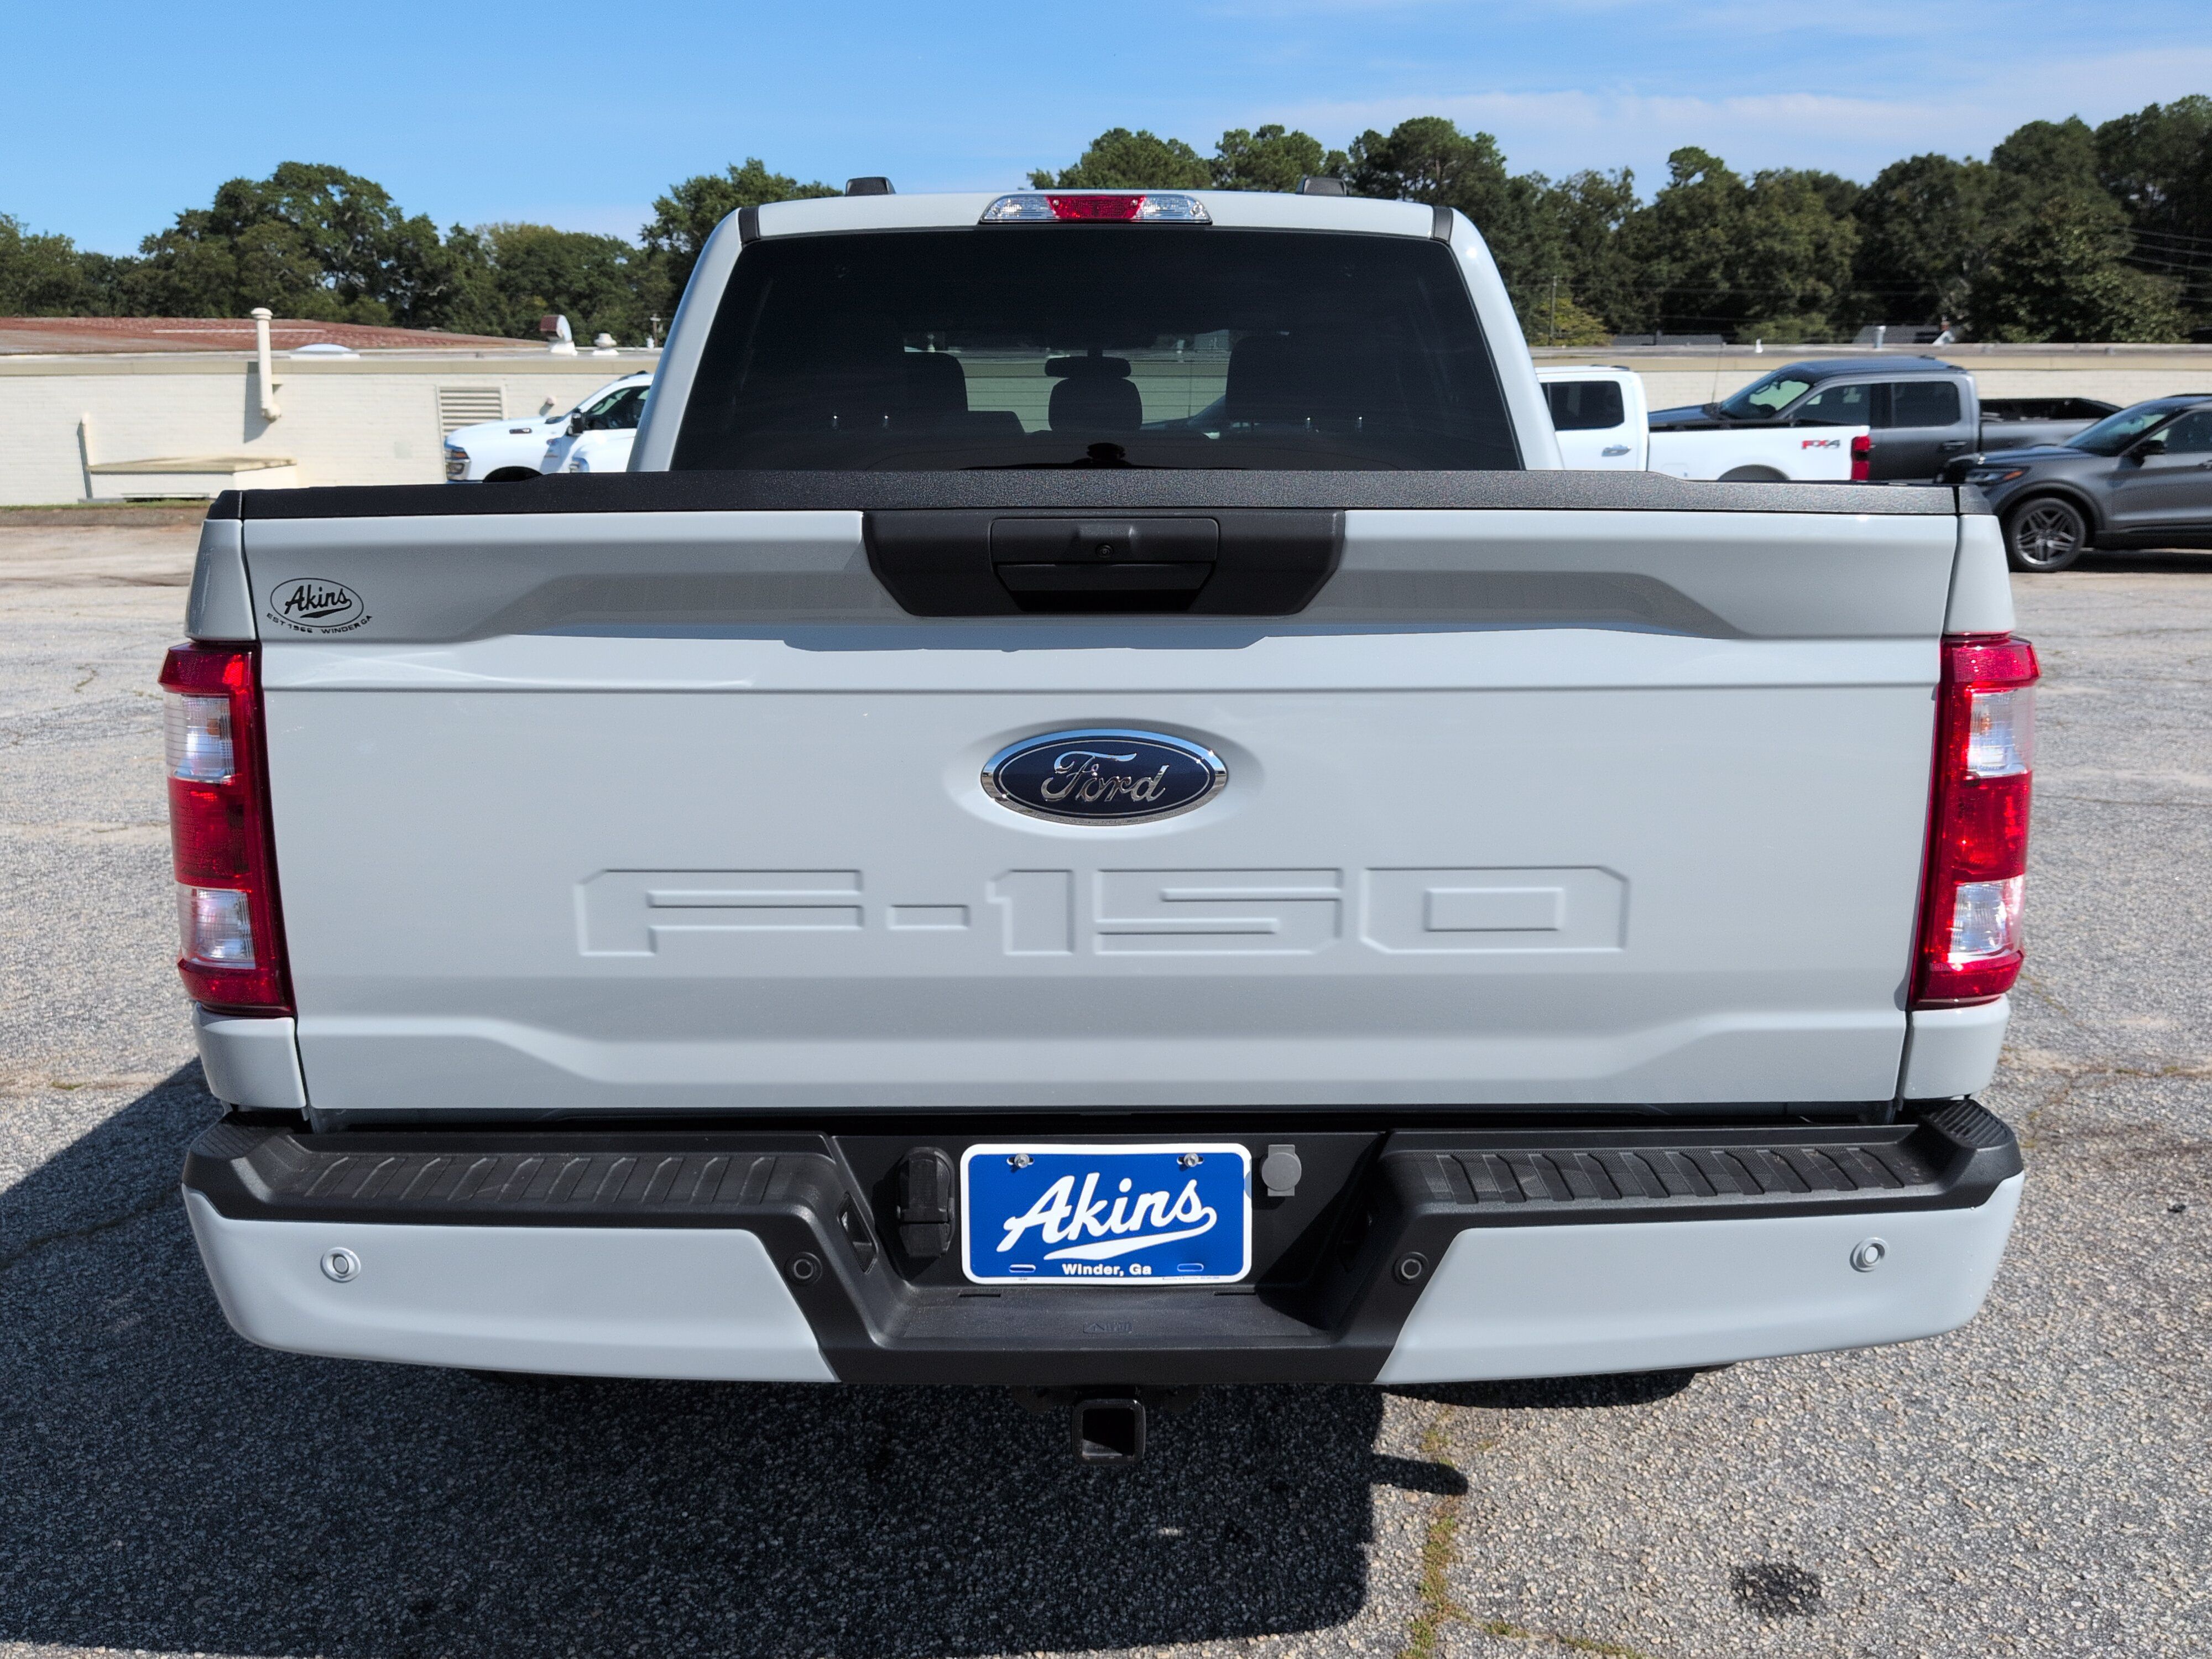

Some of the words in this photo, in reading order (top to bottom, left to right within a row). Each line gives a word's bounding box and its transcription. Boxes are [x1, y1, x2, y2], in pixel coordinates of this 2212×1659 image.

[1802, 439, 1840, 449] FX4
[284, 585, 351, 614] Akins
[267, 613, 286, 625] EST
[321, 623, 361, 634] WINDER
[361, 615, 373, 625] GA
[1041, 750, 1169, 802] Ford
[573, 866, 1630, 957] F-150
[997, 1172, 1217, 1253] Akins
[1062, 1264, 1124, 1277] Winder,
[1129, 1263, 1152, 1275] Ga
